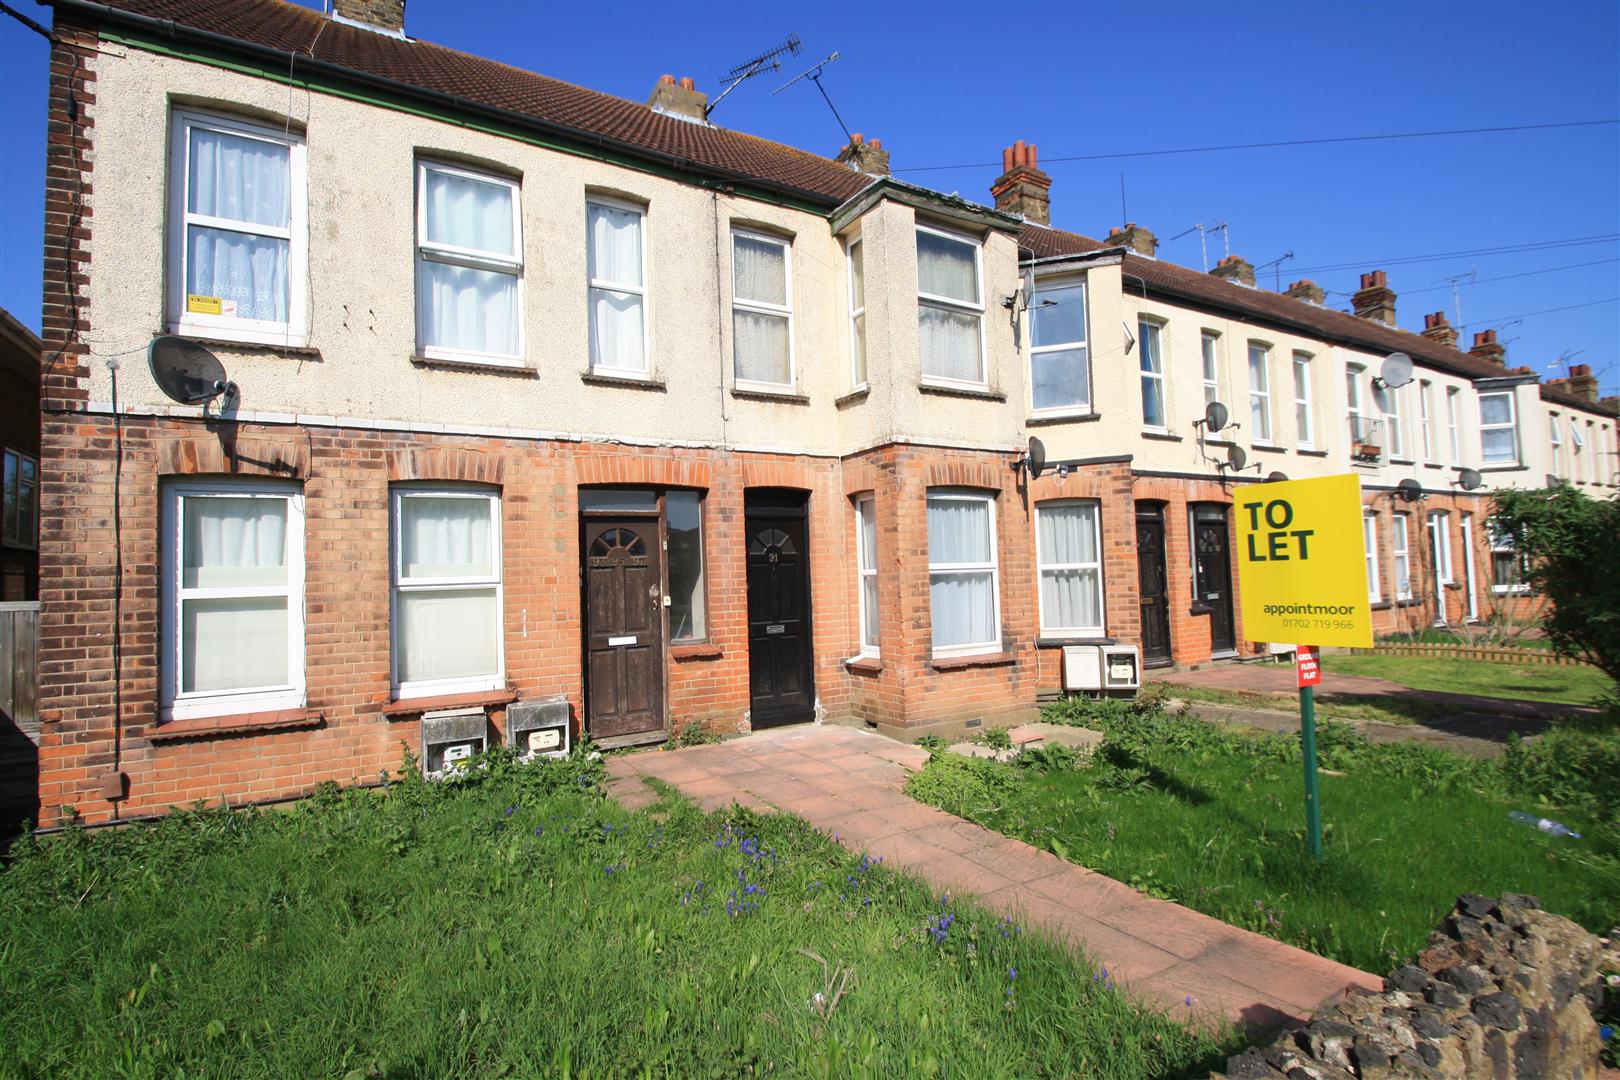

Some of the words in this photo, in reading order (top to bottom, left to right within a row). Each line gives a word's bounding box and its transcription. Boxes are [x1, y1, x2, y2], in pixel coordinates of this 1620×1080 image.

[1243, 499, 1293, 530] TO
[1247, 530, 1314, 562] LET
[769, 553, 778, 562] 91
[1263, 603, 1355, 616] appointmoor
[1282, 619, 1311, 629] 01702
[1313, 620, 1331, 629] 719
[1333, 620, 1354, 630] 966
